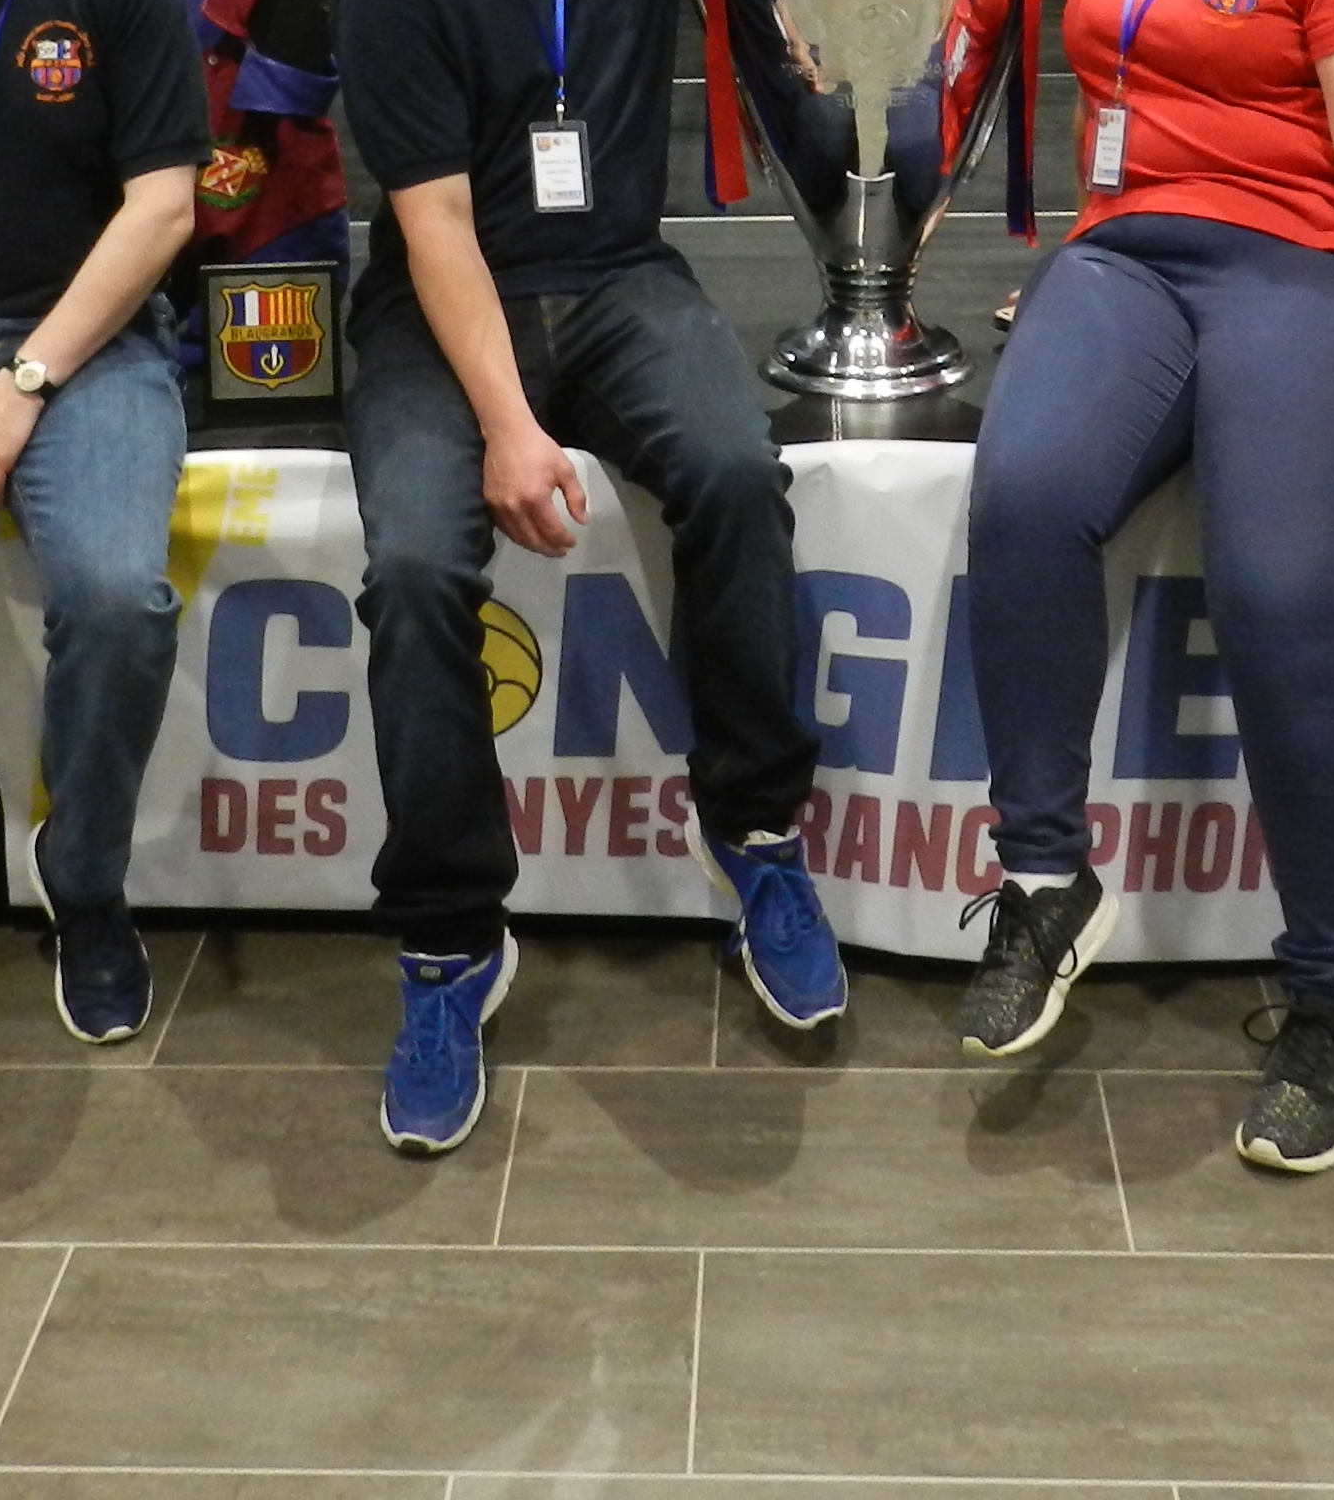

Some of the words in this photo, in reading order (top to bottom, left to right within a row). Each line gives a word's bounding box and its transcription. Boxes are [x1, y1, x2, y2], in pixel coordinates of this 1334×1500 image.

[207, 571, 1243, 780] CNGE
[200, 777, 348, 857] DES
[502, 775, 691, 857] NYES
